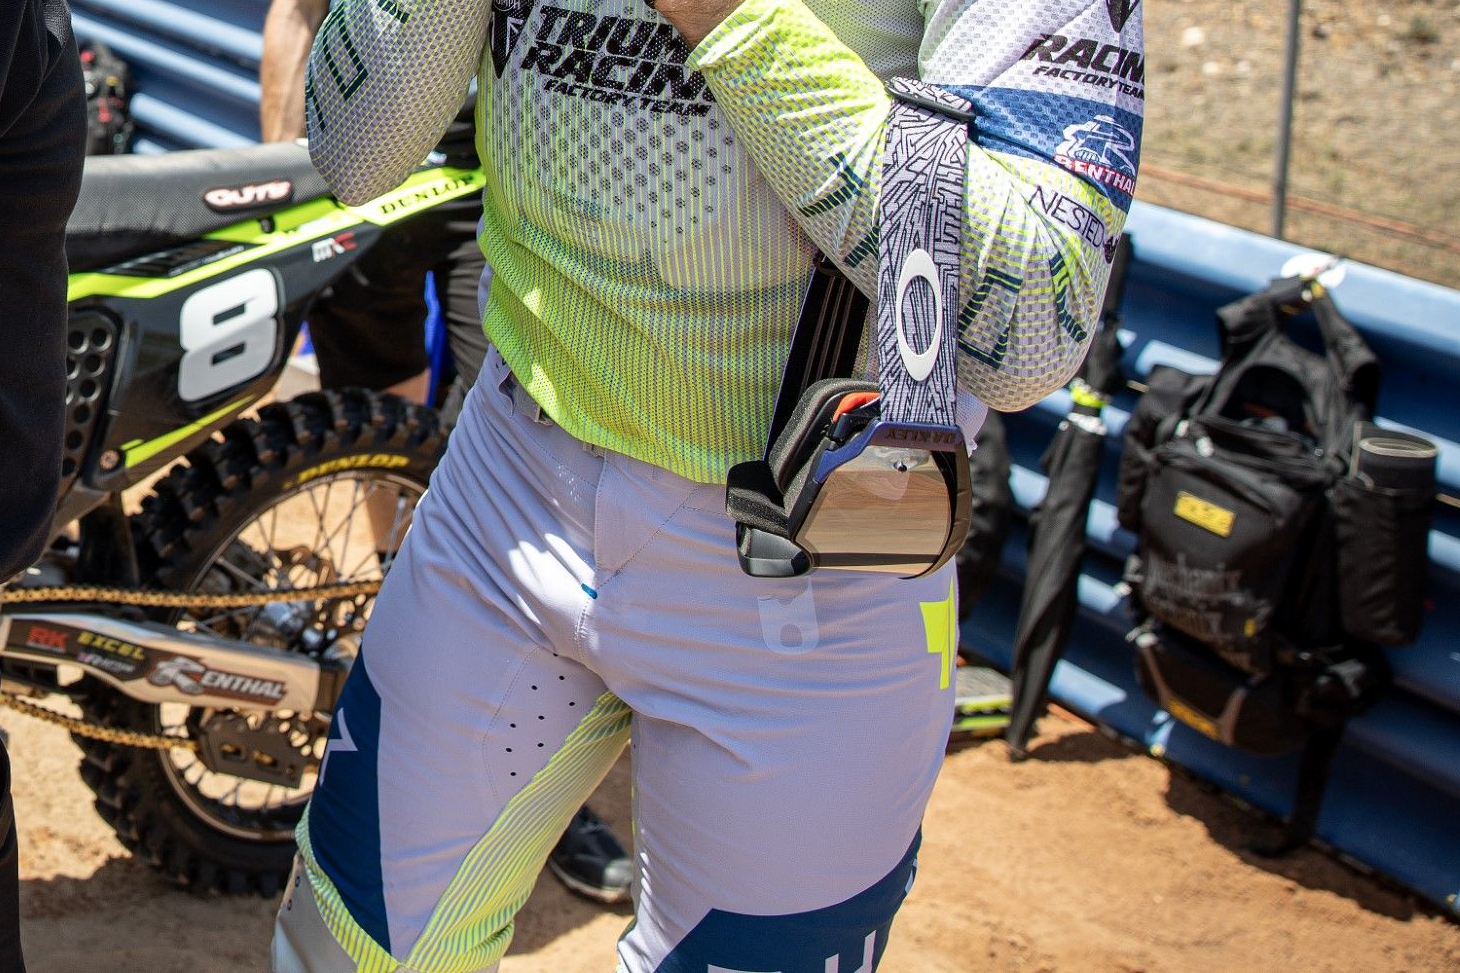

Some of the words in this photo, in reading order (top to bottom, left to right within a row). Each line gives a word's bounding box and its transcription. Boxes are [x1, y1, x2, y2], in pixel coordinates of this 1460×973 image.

[536, 4, 692, 65] TRIUM
[521, 43, 718, 103] RACIN
[1019, 33, 1145, 85] RACIN
[1032, 65, 1120, 89] FACTORY
[544, 79, 637, 107] FACTORY
[639, 96, 712, 118] TEAM
[380, 174, 475, 216] DUNLOP
[177, 266, 280, 404] 8
[28, 625, 68, 649] RK
[77, 631, 145, 660] EXCEL
